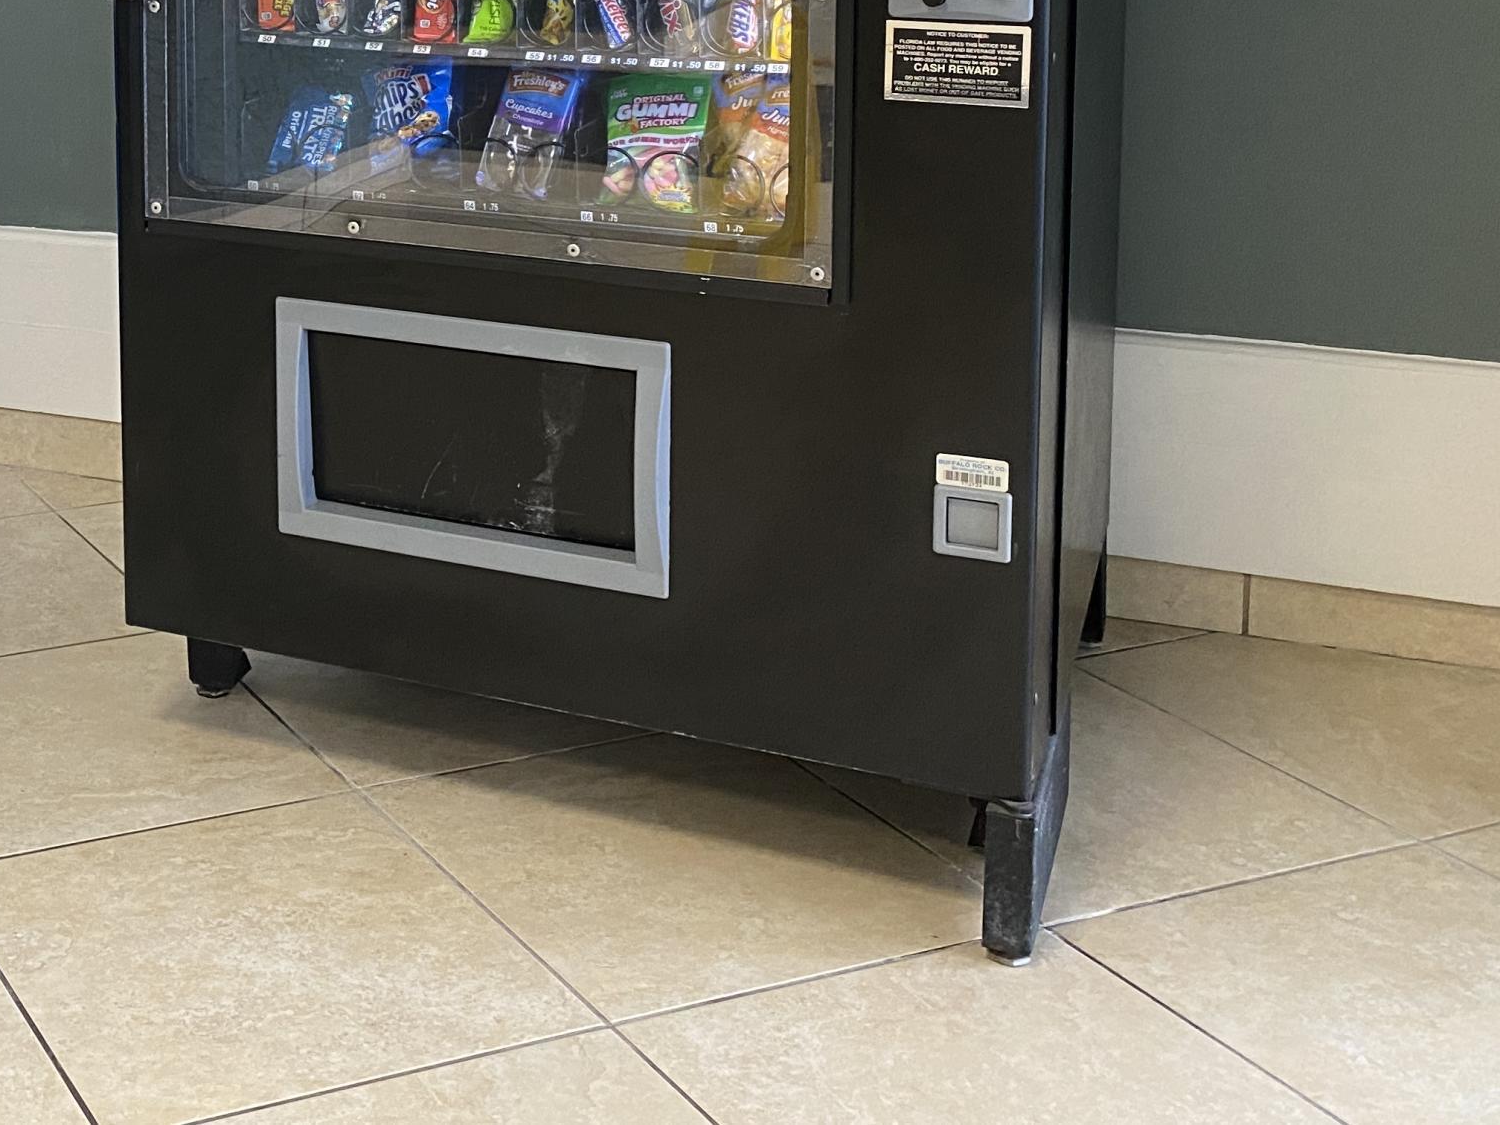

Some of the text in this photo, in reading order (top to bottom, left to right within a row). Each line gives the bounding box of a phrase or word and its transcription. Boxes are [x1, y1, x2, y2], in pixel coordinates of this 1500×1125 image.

[913, 62, 999, 76] CASH REWARD
[633, 93, 686, 105] ORIGINAL
[505, 97, 554, 120] Cupcakes
[616, 102, 698, 121] GUMMI
[639, 117, 688, 129] FACTORY
